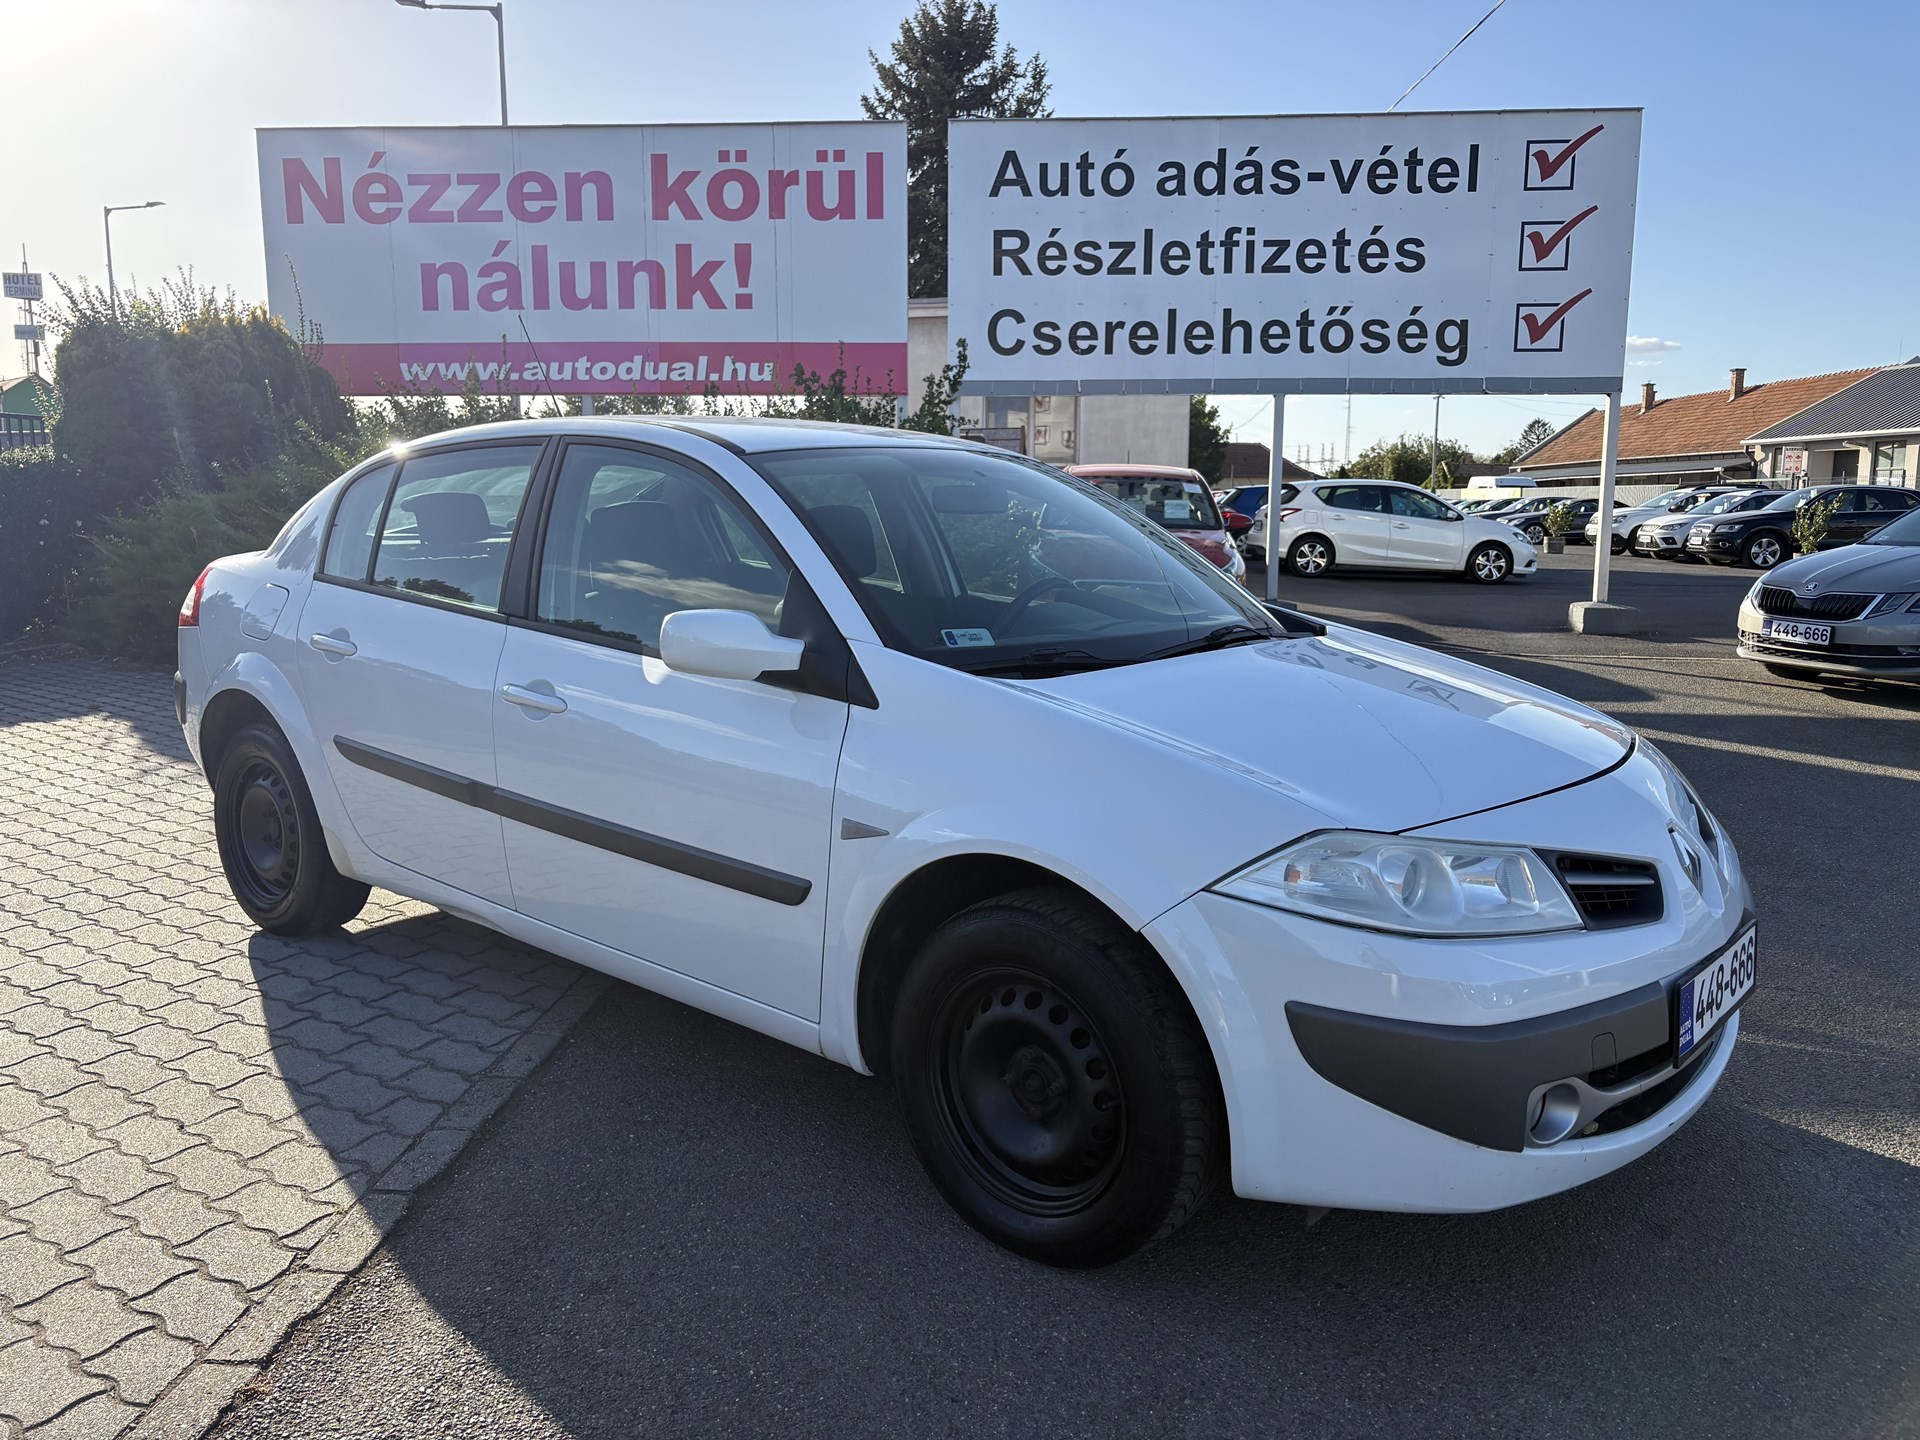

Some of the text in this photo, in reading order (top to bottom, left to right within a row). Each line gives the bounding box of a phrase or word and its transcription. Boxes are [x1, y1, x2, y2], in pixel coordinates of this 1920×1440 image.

[282, 149, 885, 224] Nézzen körül
[988, 144, 1480, 198] Autó adás-vétel
[420, 240, 753, 312] nálunk!
[991, 225, 1427, 277] Részletfizetés
[5, 274, 40, 285] HOTEL
[5, 285, 42, 297] TERMINAL
[987, 305, 1471, 367] Cserelehetőség
[399, 355, 774, 382] www.autodual.hu
[1773, 622, 1829, 642] 448-666
[1696, 936, 1754, 1028] 448-666
